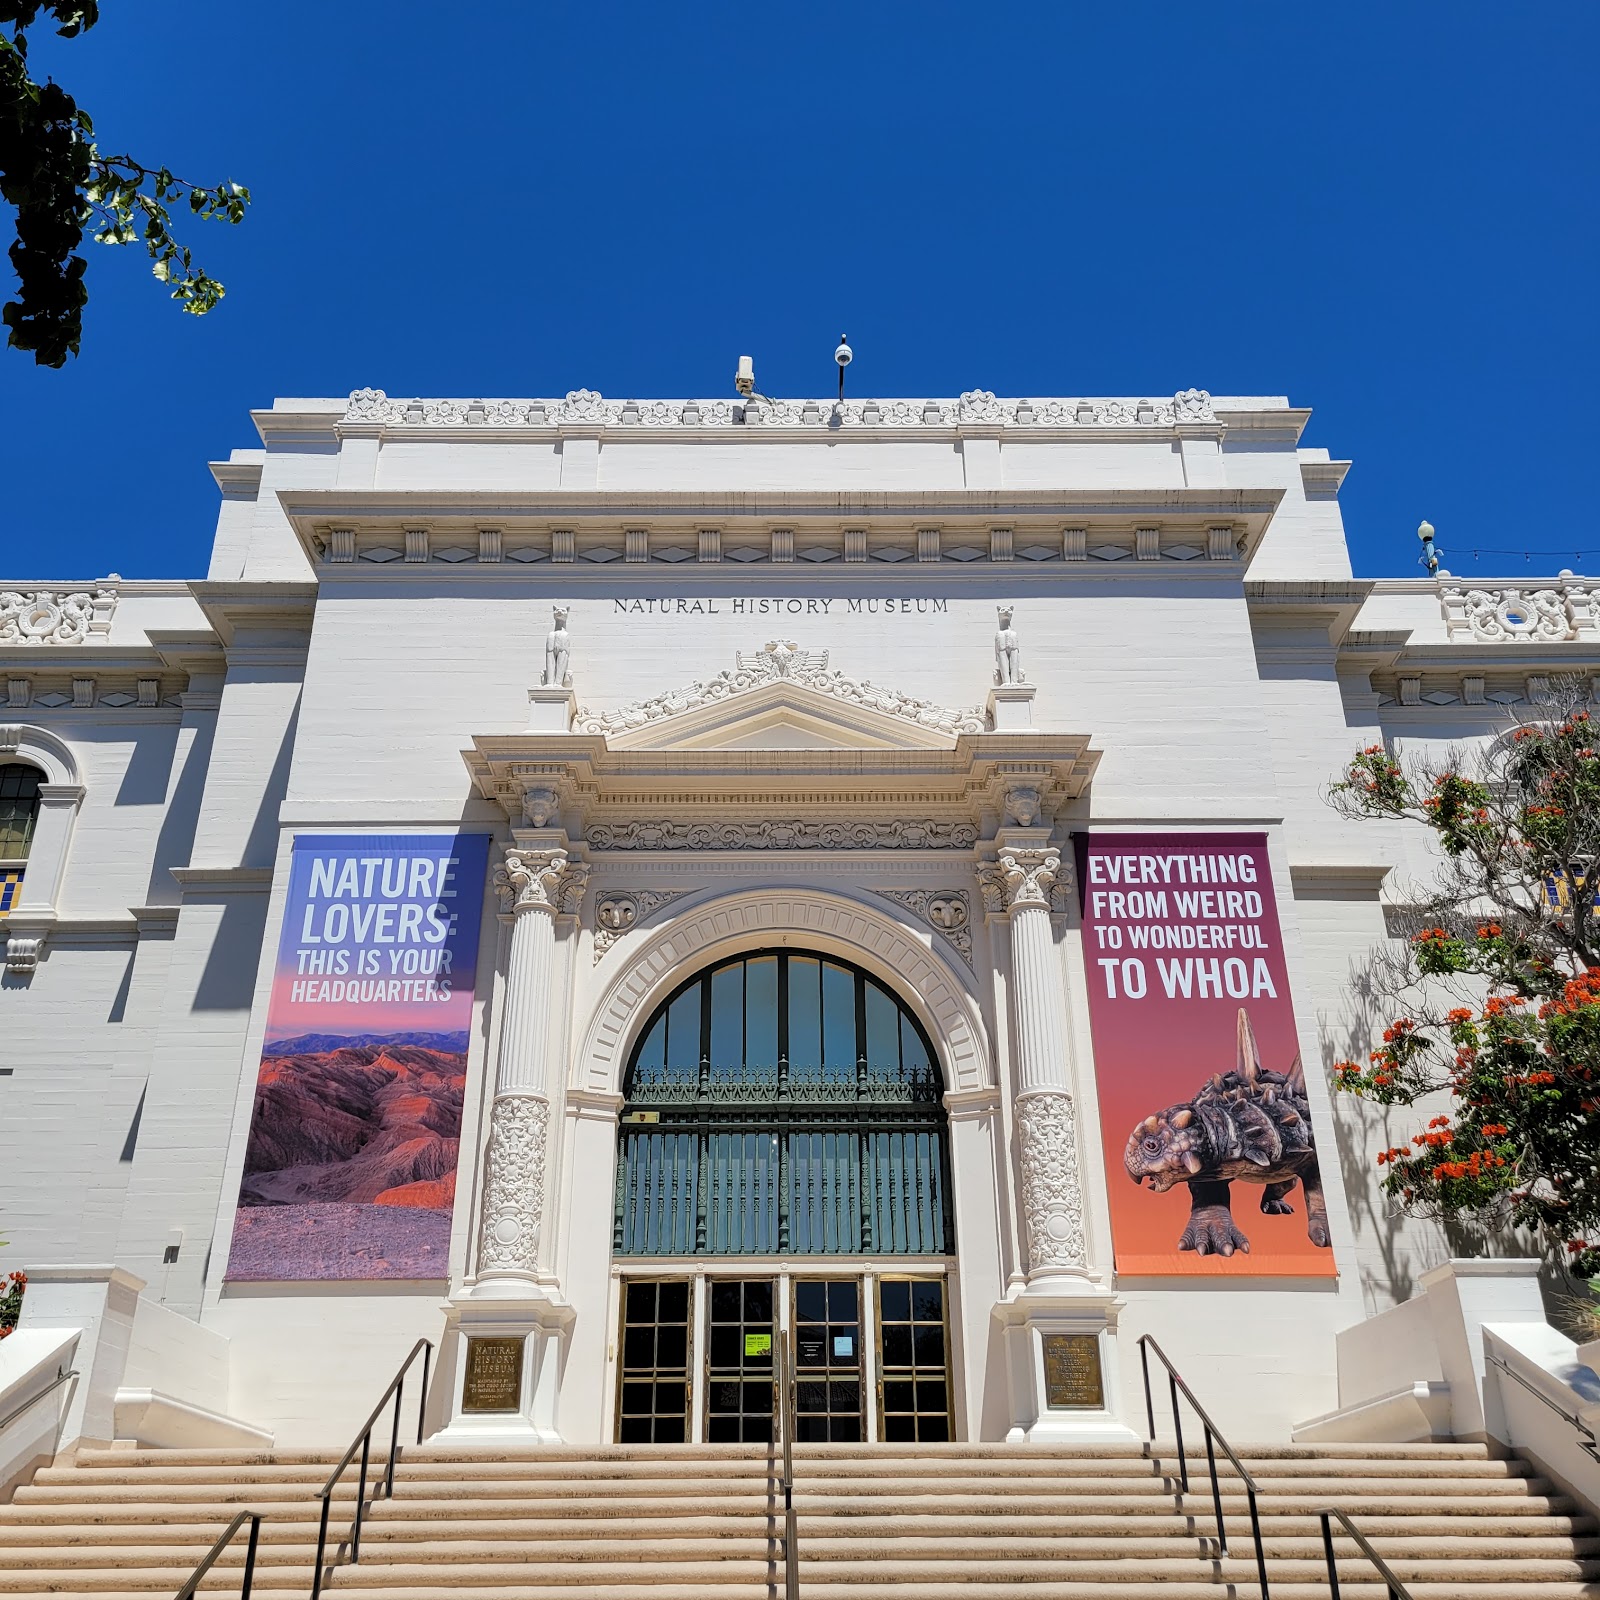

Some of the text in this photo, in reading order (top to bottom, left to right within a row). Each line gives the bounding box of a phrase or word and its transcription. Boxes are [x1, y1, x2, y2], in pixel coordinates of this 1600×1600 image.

[613, 598, 949, 614] NATURAL HISTORY MUSEUM
[308, 857, 460, 898] NATURE
[1088, 854, 1258, 884] EVERYTHING
[1092, 890, 1263, 919] FROM WEIRD
[301, 903, 459, 944] LOVERS:
[1094, 925, 1268, 949] TO WONDERFUL
[296, 948, 453, 975] THIS IS YOUR
[290, 979, 453, 1004] HEADQUARTERS
[1097, 957, 1278, 999] TO WHOA
[474, 1365, 515, 1373] MUSEUM
